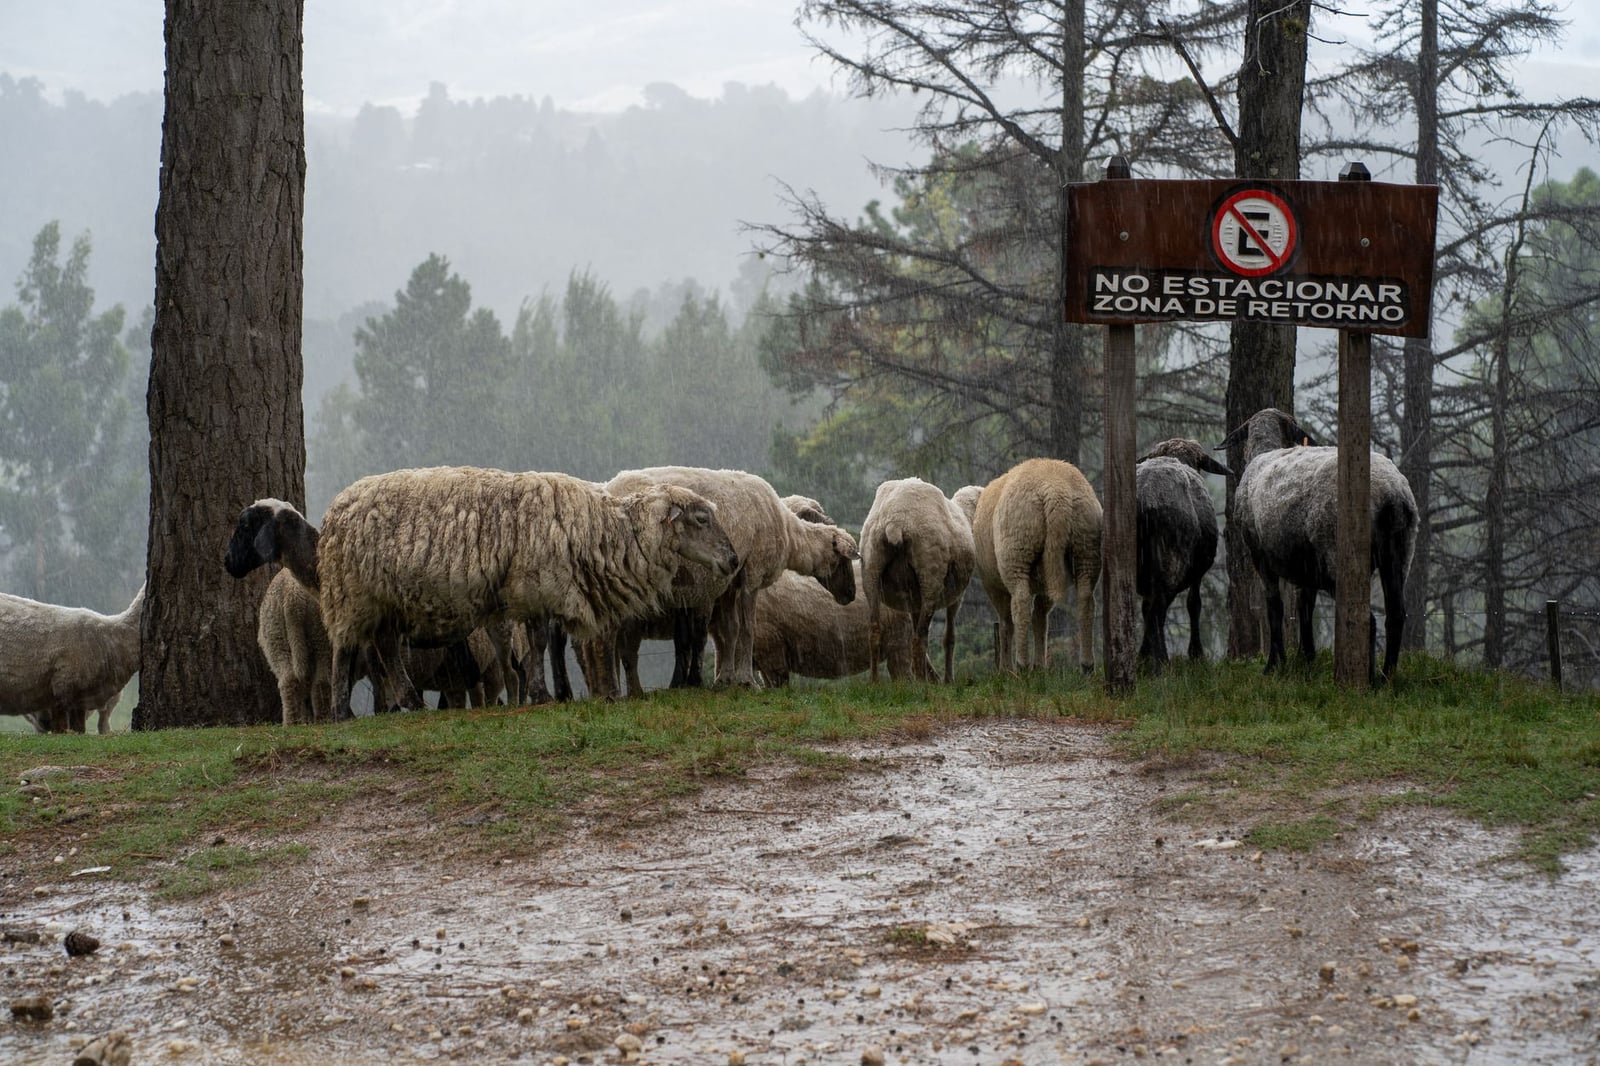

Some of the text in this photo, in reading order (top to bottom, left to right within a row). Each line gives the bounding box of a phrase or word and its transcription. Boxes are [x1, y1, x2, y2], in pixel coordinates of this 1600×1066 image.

[1095, 273, 1402, 303] NO ESTACIONAR
[1093, 295, 1405, 322] ZONA DE RETORNO
